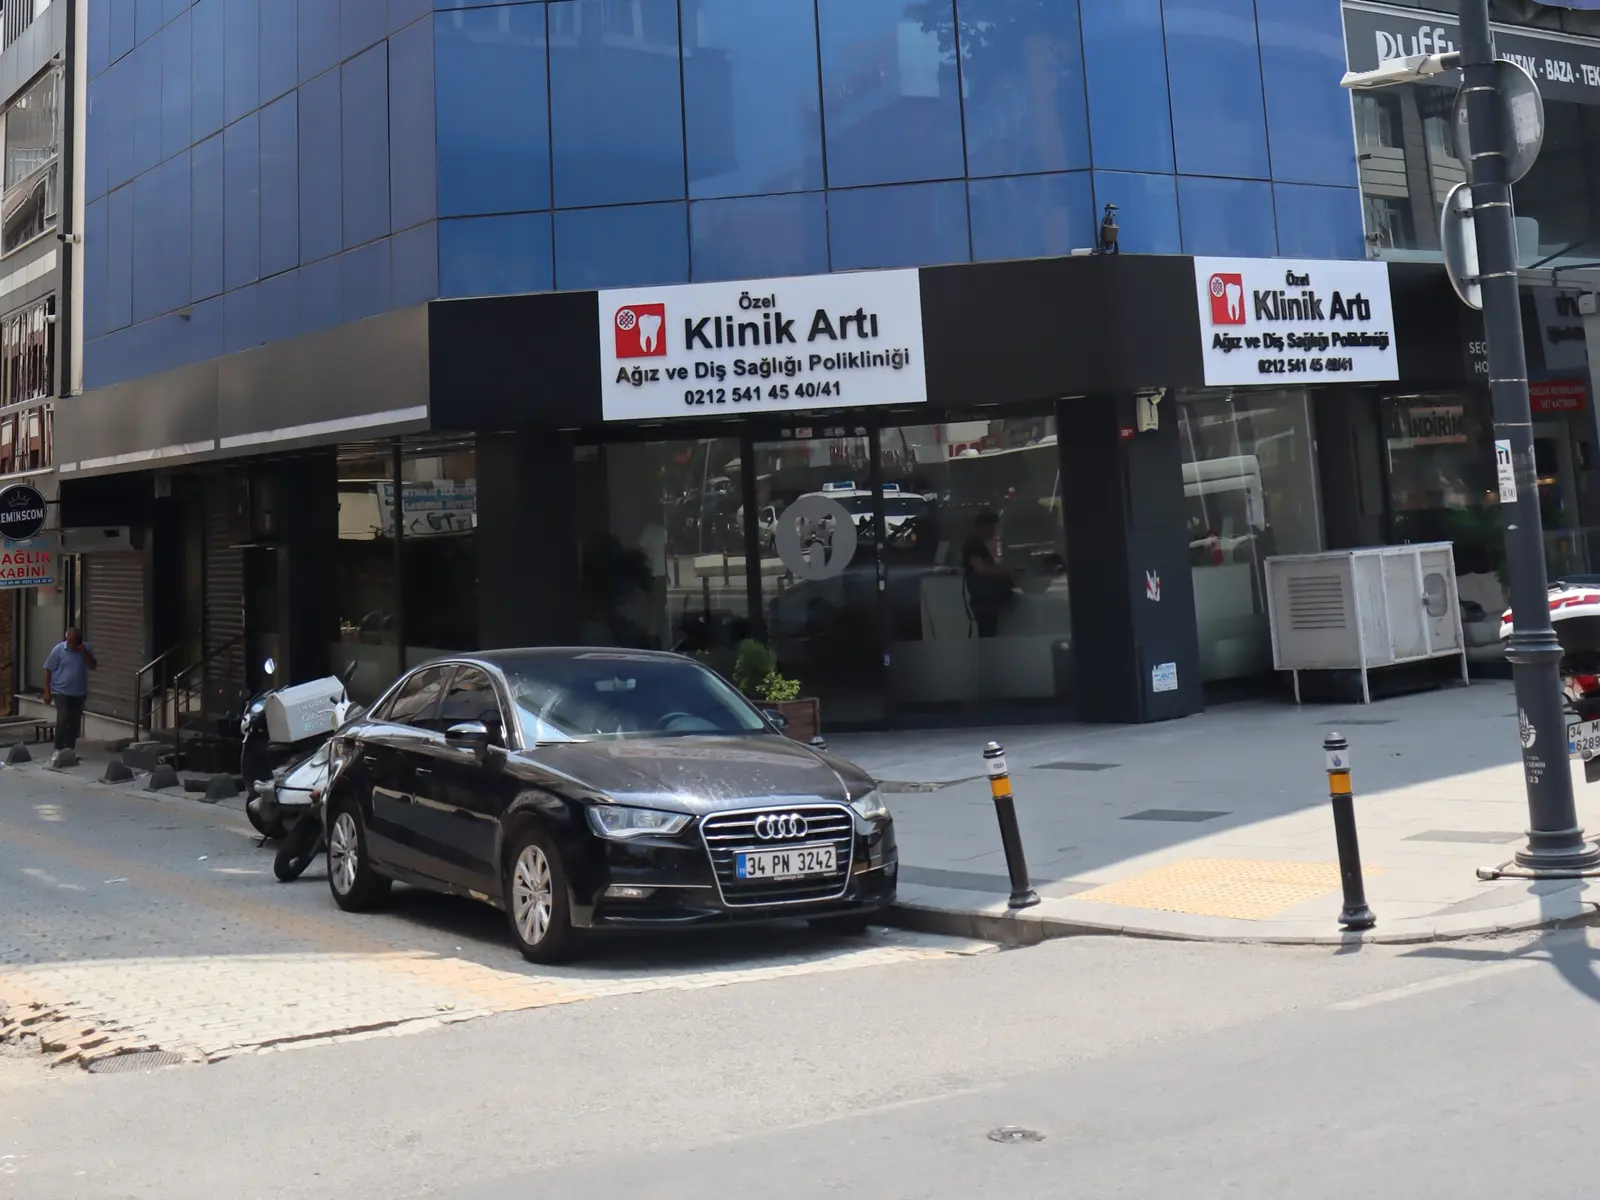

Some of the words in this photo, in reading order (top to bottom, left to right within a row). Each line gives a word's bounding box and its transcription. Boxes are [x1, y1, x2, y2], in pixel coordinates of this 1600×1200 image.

[1545, 59, 1575, 83] BAZA
[1286, 270, 1310, 286] Özel
[738, 292, 775, 310] Özel
[1253, 290, 1325, 321] Klinik
[1330, 291, 1371, 321] Artı
[684, 311, 796, 350] Klinik
[807, 306, 878, 342] Artı
[1212, 332, 1243, 353] Ağız
[1245, 336, 1261, 349] ve
[1263, 332, 1284, 352] Diş
[615, 366, 660, 388] Ağız
[665, 366, 688, 380] ve
[695, 360, 726, 382] Diş
[733, 355, 802, 379] Sağlığı
[809, 348, 910, 372] Polikliniği
[1258, 359, 1286, 374] 0212
[1287, 358, 1307, 373] 541
[1309, 358, 1324, 372] 45
[684, 389, 726, 406] 0212
[732, 385, 761, 402] 541
[768, 383, 790, 400] 45
[795, 380, 841, 399] 40/41
[1570, 725, 1582, 738] 34
[747, 856, 766, 876] 34
[772, 853, 790, 874] PN
[797, 850, 832, 872] 3242
